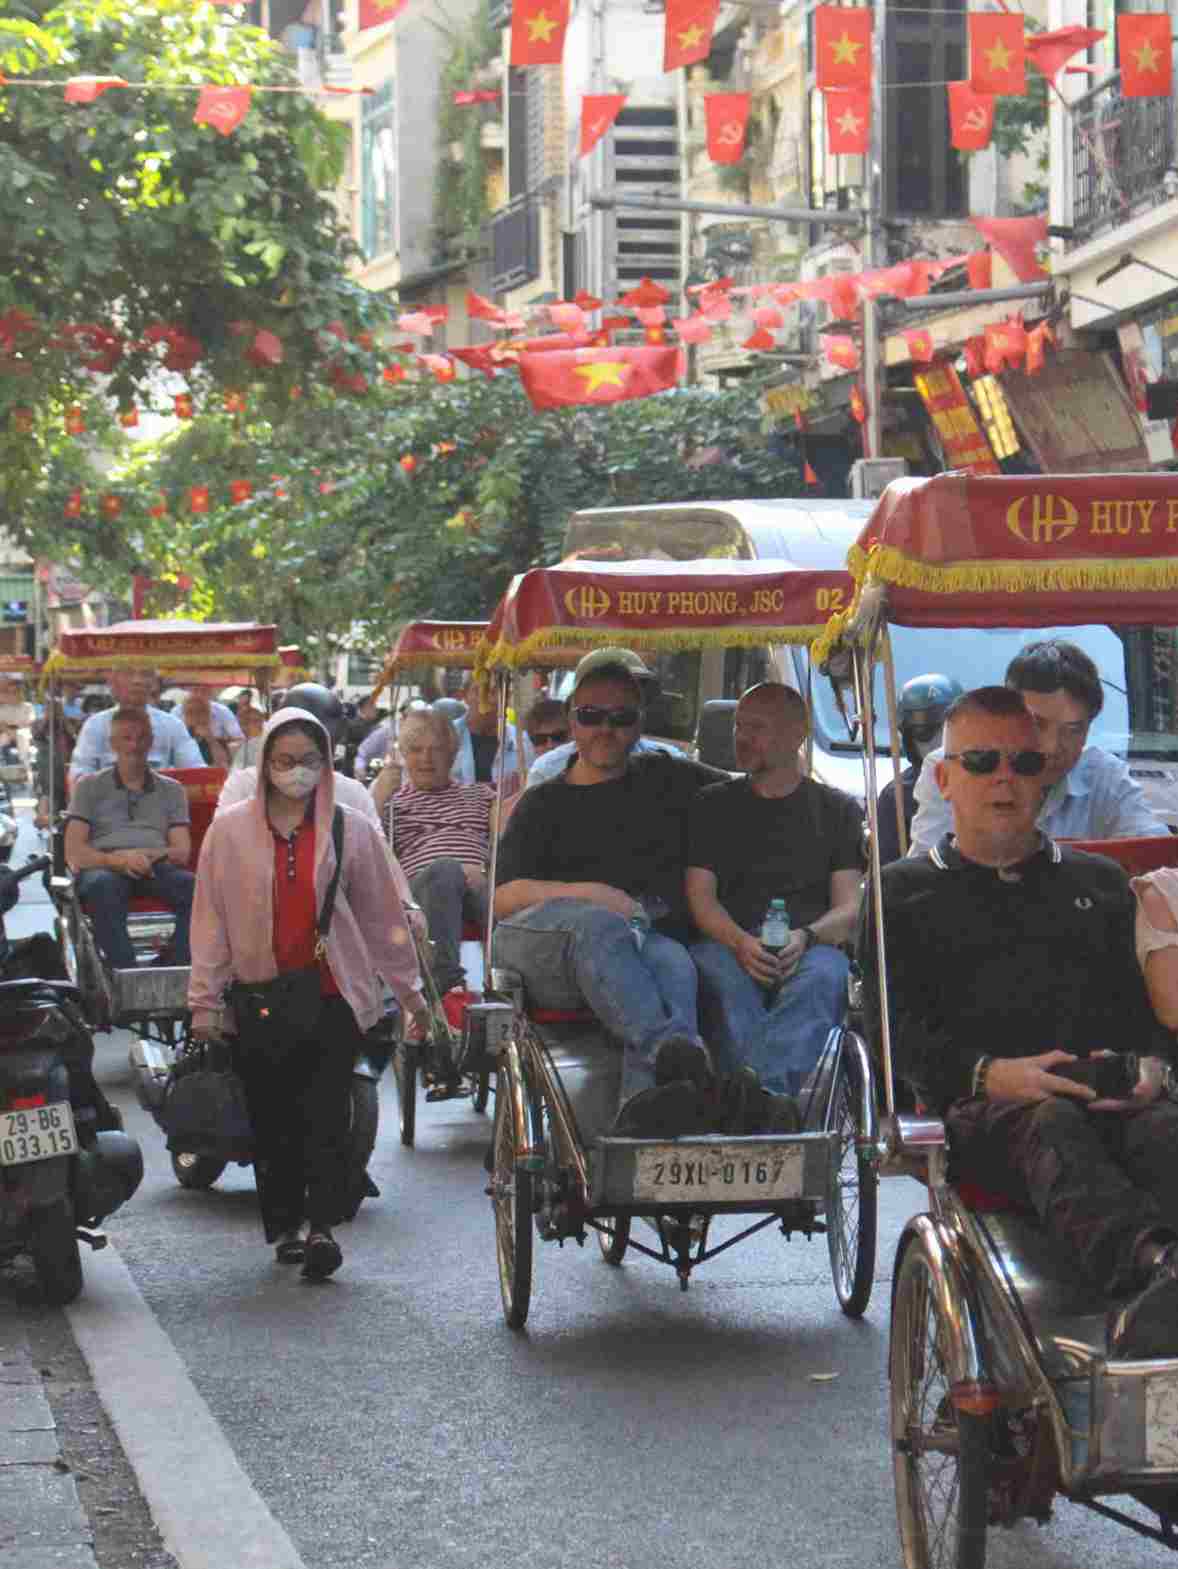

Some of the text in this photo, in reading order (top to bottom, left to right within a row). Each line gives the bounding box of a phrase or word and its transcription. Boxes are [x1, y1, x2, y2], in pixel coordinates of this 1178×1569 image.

[1089, 500, 1157, 534] HUY
[618, 590, 661, 615] HUY
[750, 588, 784, 613] JSC
[816, 587, 844, 611] 02
[3, 1128, 72, 1160] 033.15
[652, 1159, 785, 1187] 29XL-0167
